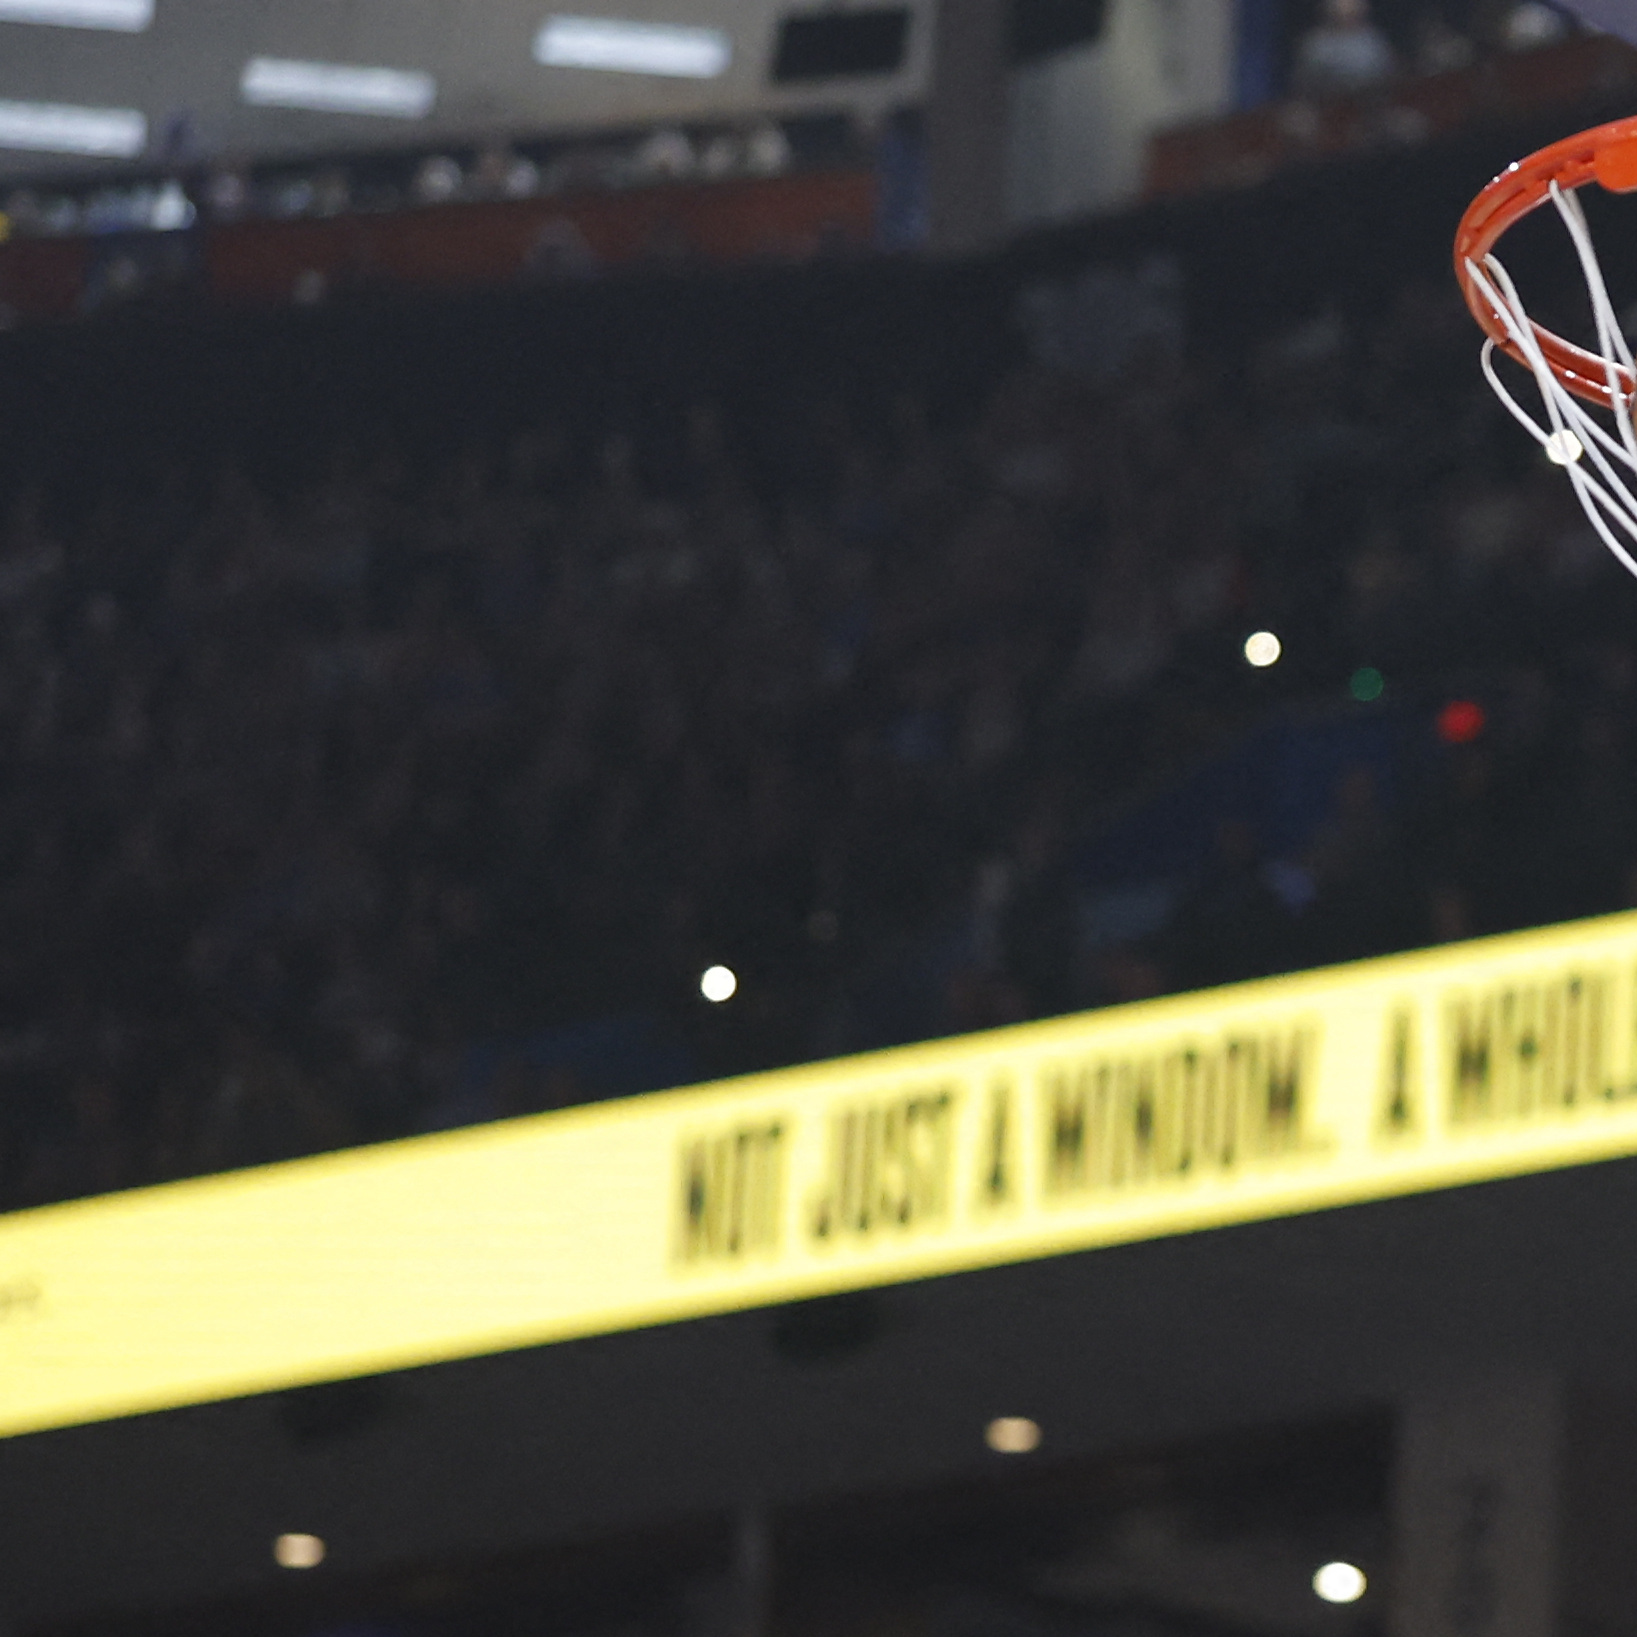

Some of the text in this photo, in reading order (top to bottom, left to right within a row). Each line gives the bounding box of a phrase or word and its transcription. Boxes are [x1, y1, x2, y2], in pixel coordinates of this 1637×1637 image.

[671, 1113, 791, 1270] NOT
[977, 1076, 1017, 1211] A
[1375, 1005, 1419, 1141] A
